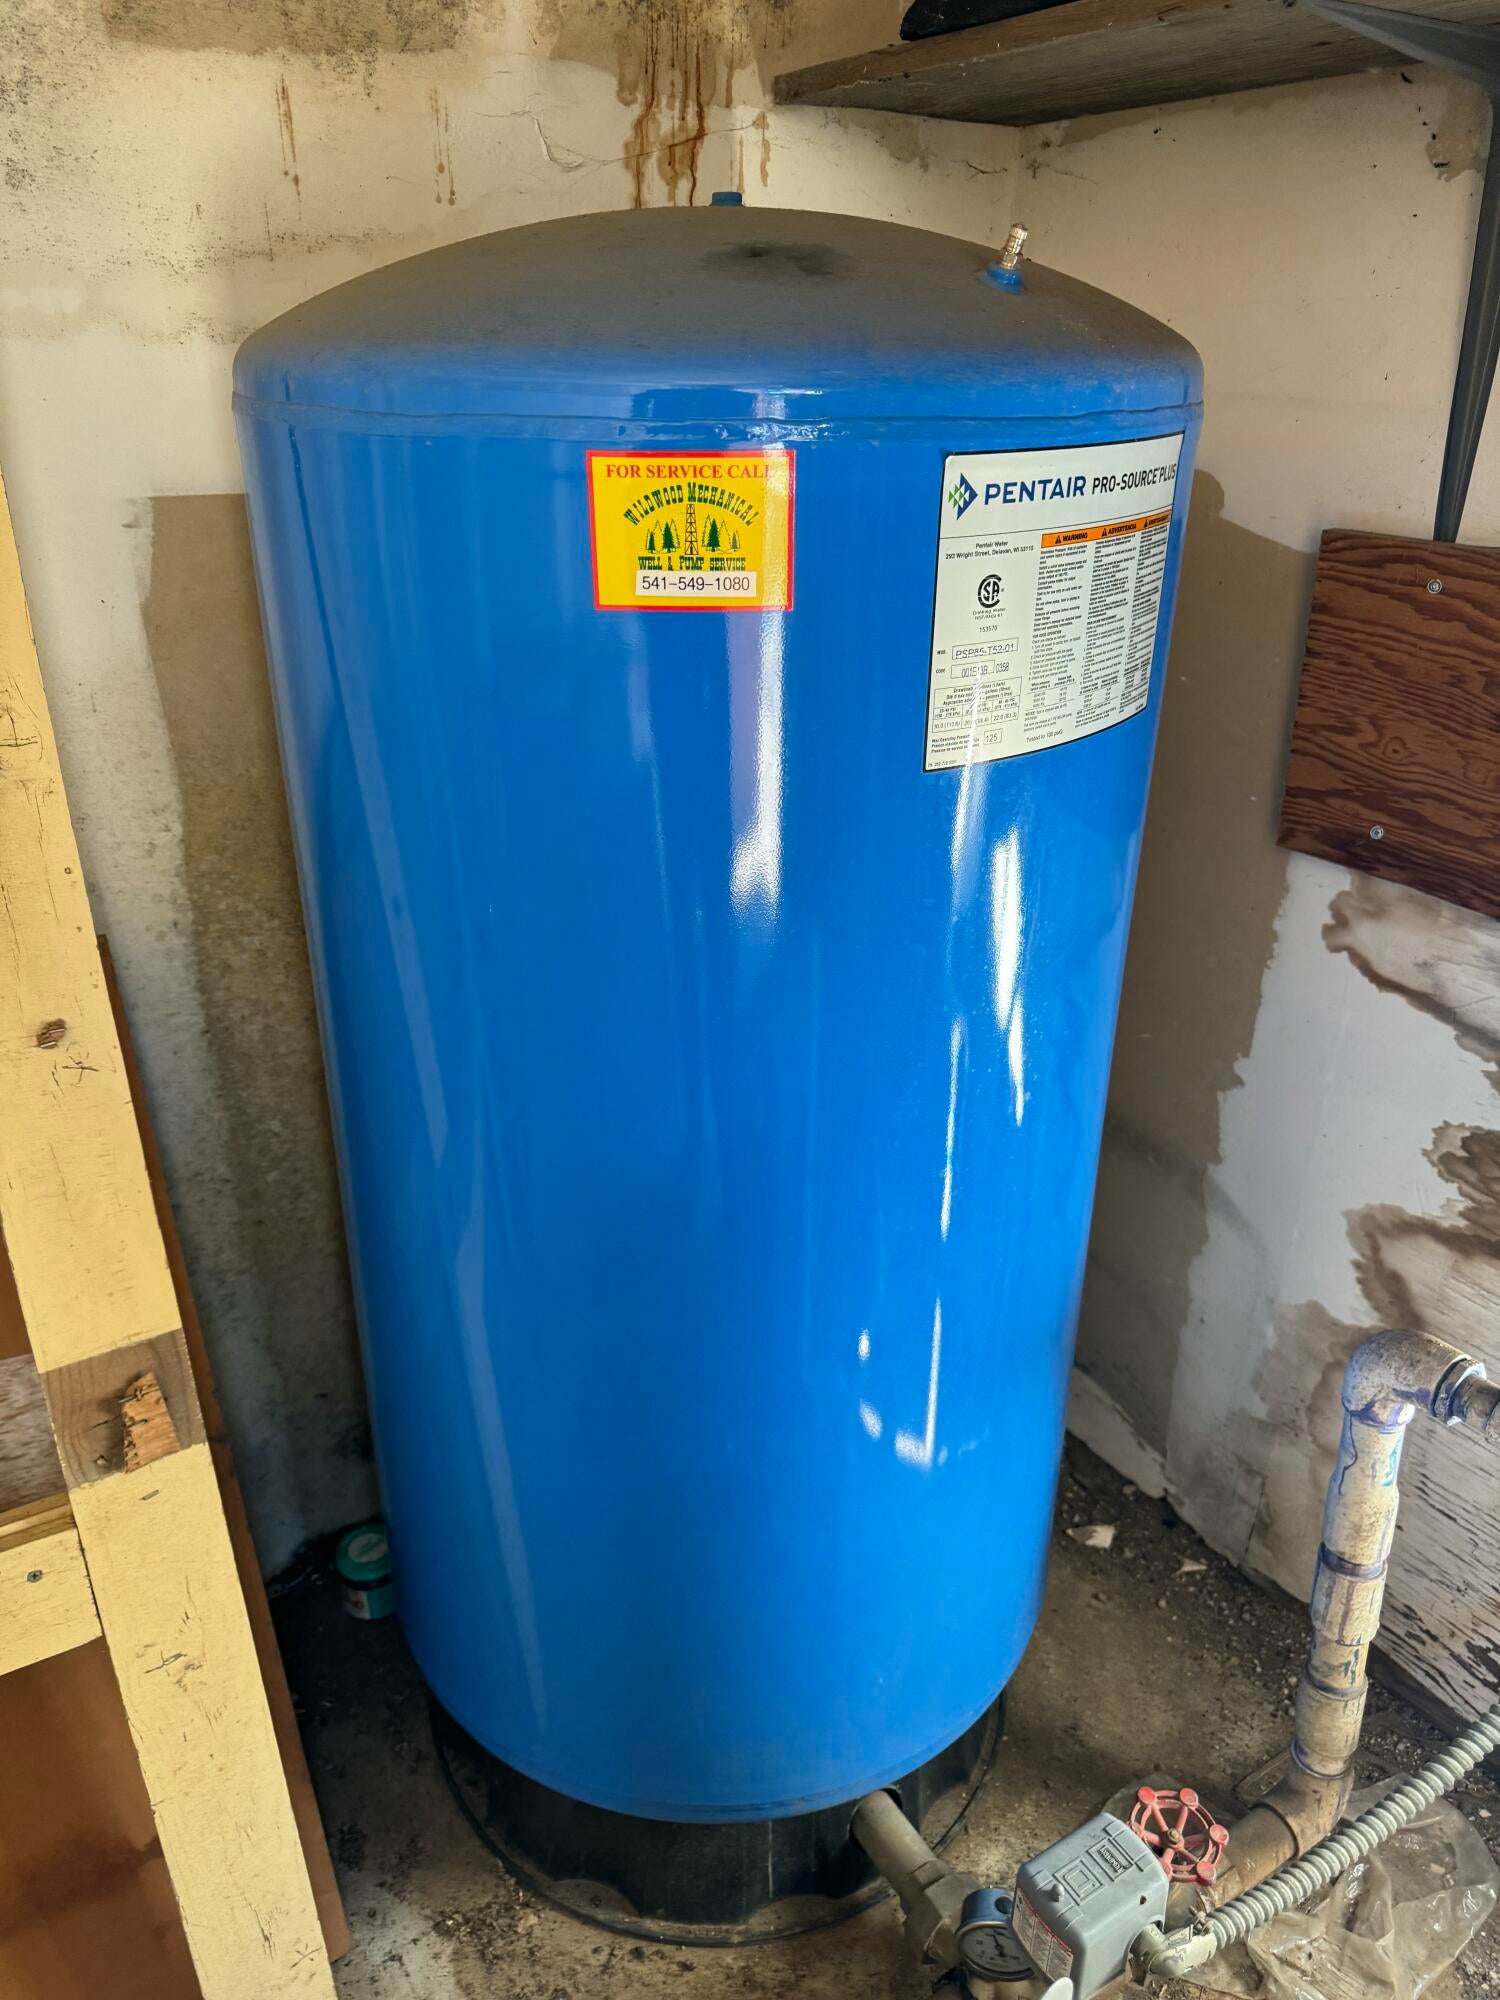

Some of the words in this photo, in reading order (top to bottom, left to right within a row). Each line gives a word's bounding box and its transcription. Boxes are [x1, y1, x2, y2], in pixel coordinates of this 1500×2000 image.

[606, 464, 641, 479] FOR
[647, 464, 723, 479] SERVICE
[984, 476, 1086, 505] PENTAIR
[623, 484, 684, 526] WILDWOOD
[687, 481, 760, 526] MECHANICAL
[1062, 532, 1088, 542] WARNING
[956, 551, 974, 560] Wright
[638, 556, 662, 571] WELL
[667, 557, 674, 571] &
[679, 556, 705, 571] PUMP
[709, 557, 746, 571] SERVICE
[642, 576, 750, 592] 541-549-1080
[985, 733, 998, 743] 125
